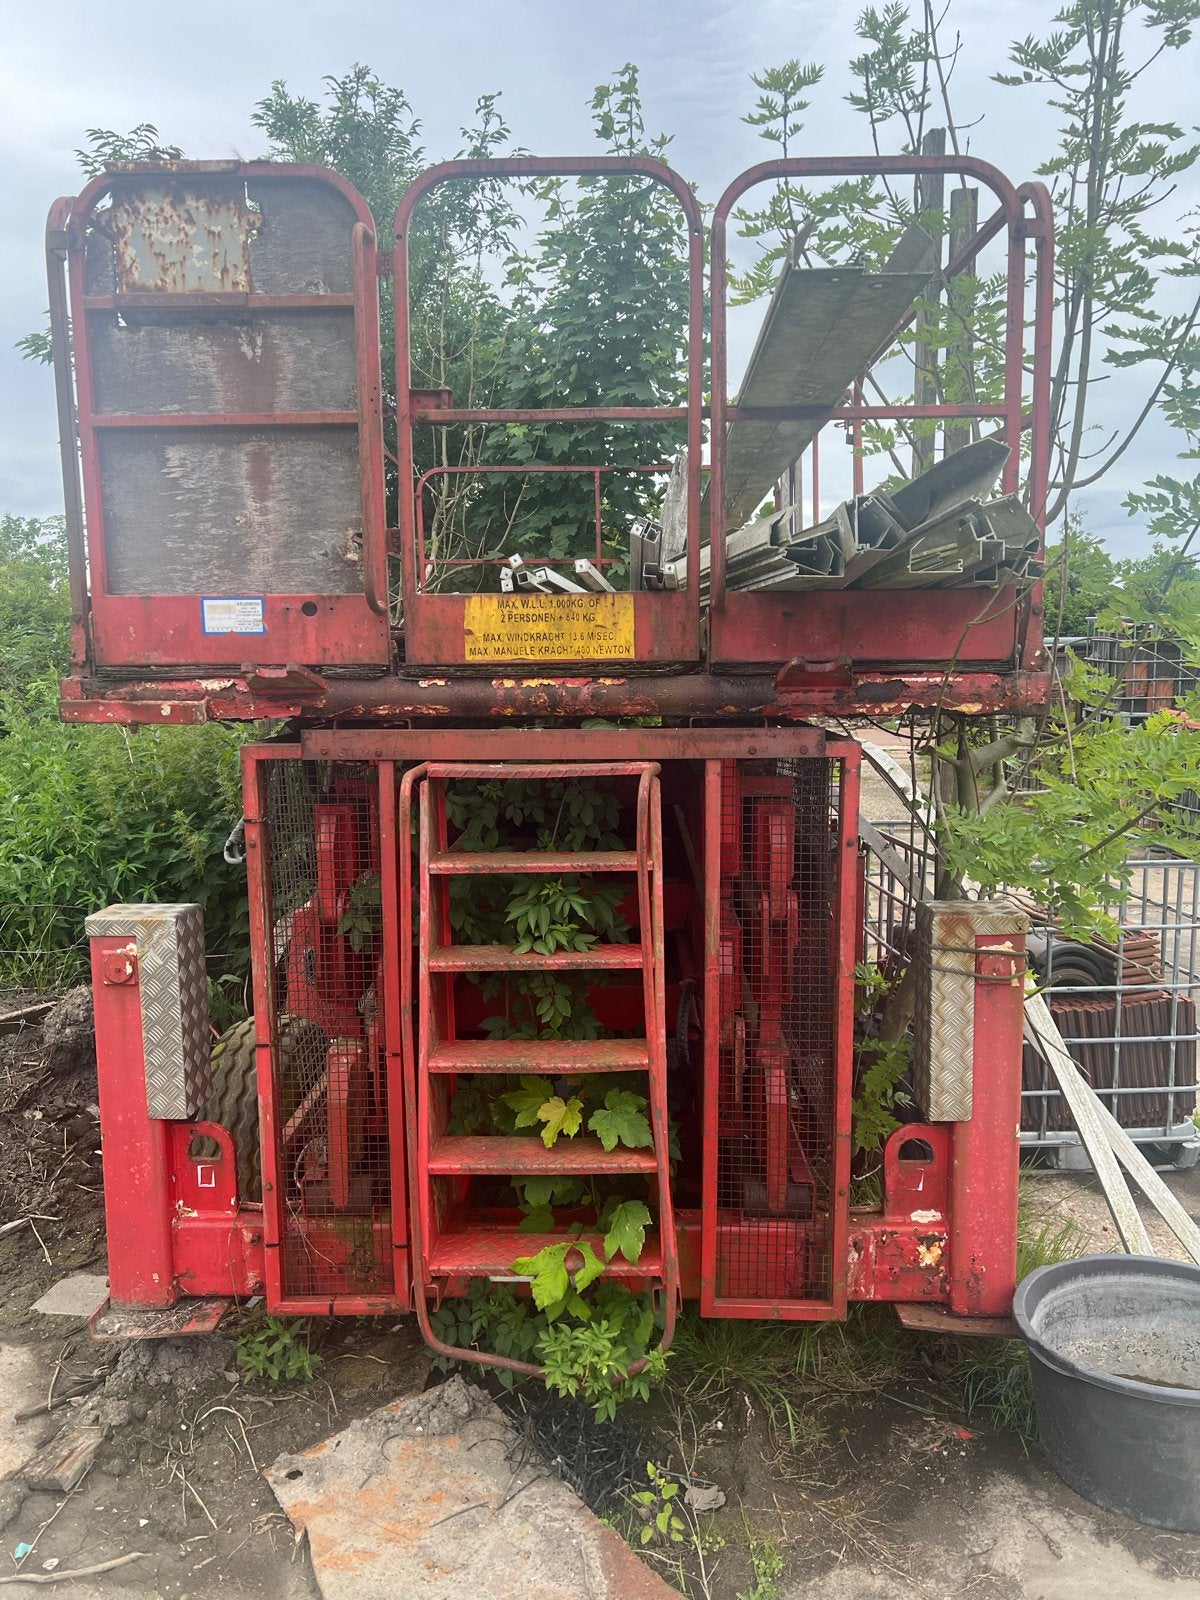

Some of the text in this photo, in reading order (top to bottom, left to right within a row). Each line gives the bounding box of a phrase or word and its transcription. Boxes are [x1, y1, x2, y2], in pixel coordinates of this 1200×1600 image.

[588, 598, 600, 608] OF
[500, 613, 506, 623] 2
[508, 613, 555, 623] PERSONEN
[506, 632, 565, 642] WINDKRACHT
[493, 646, 535, 656] MANUELE
[538, 645, 574, 655] KRACHT
[593, 645, 631, 655] NEWTON
